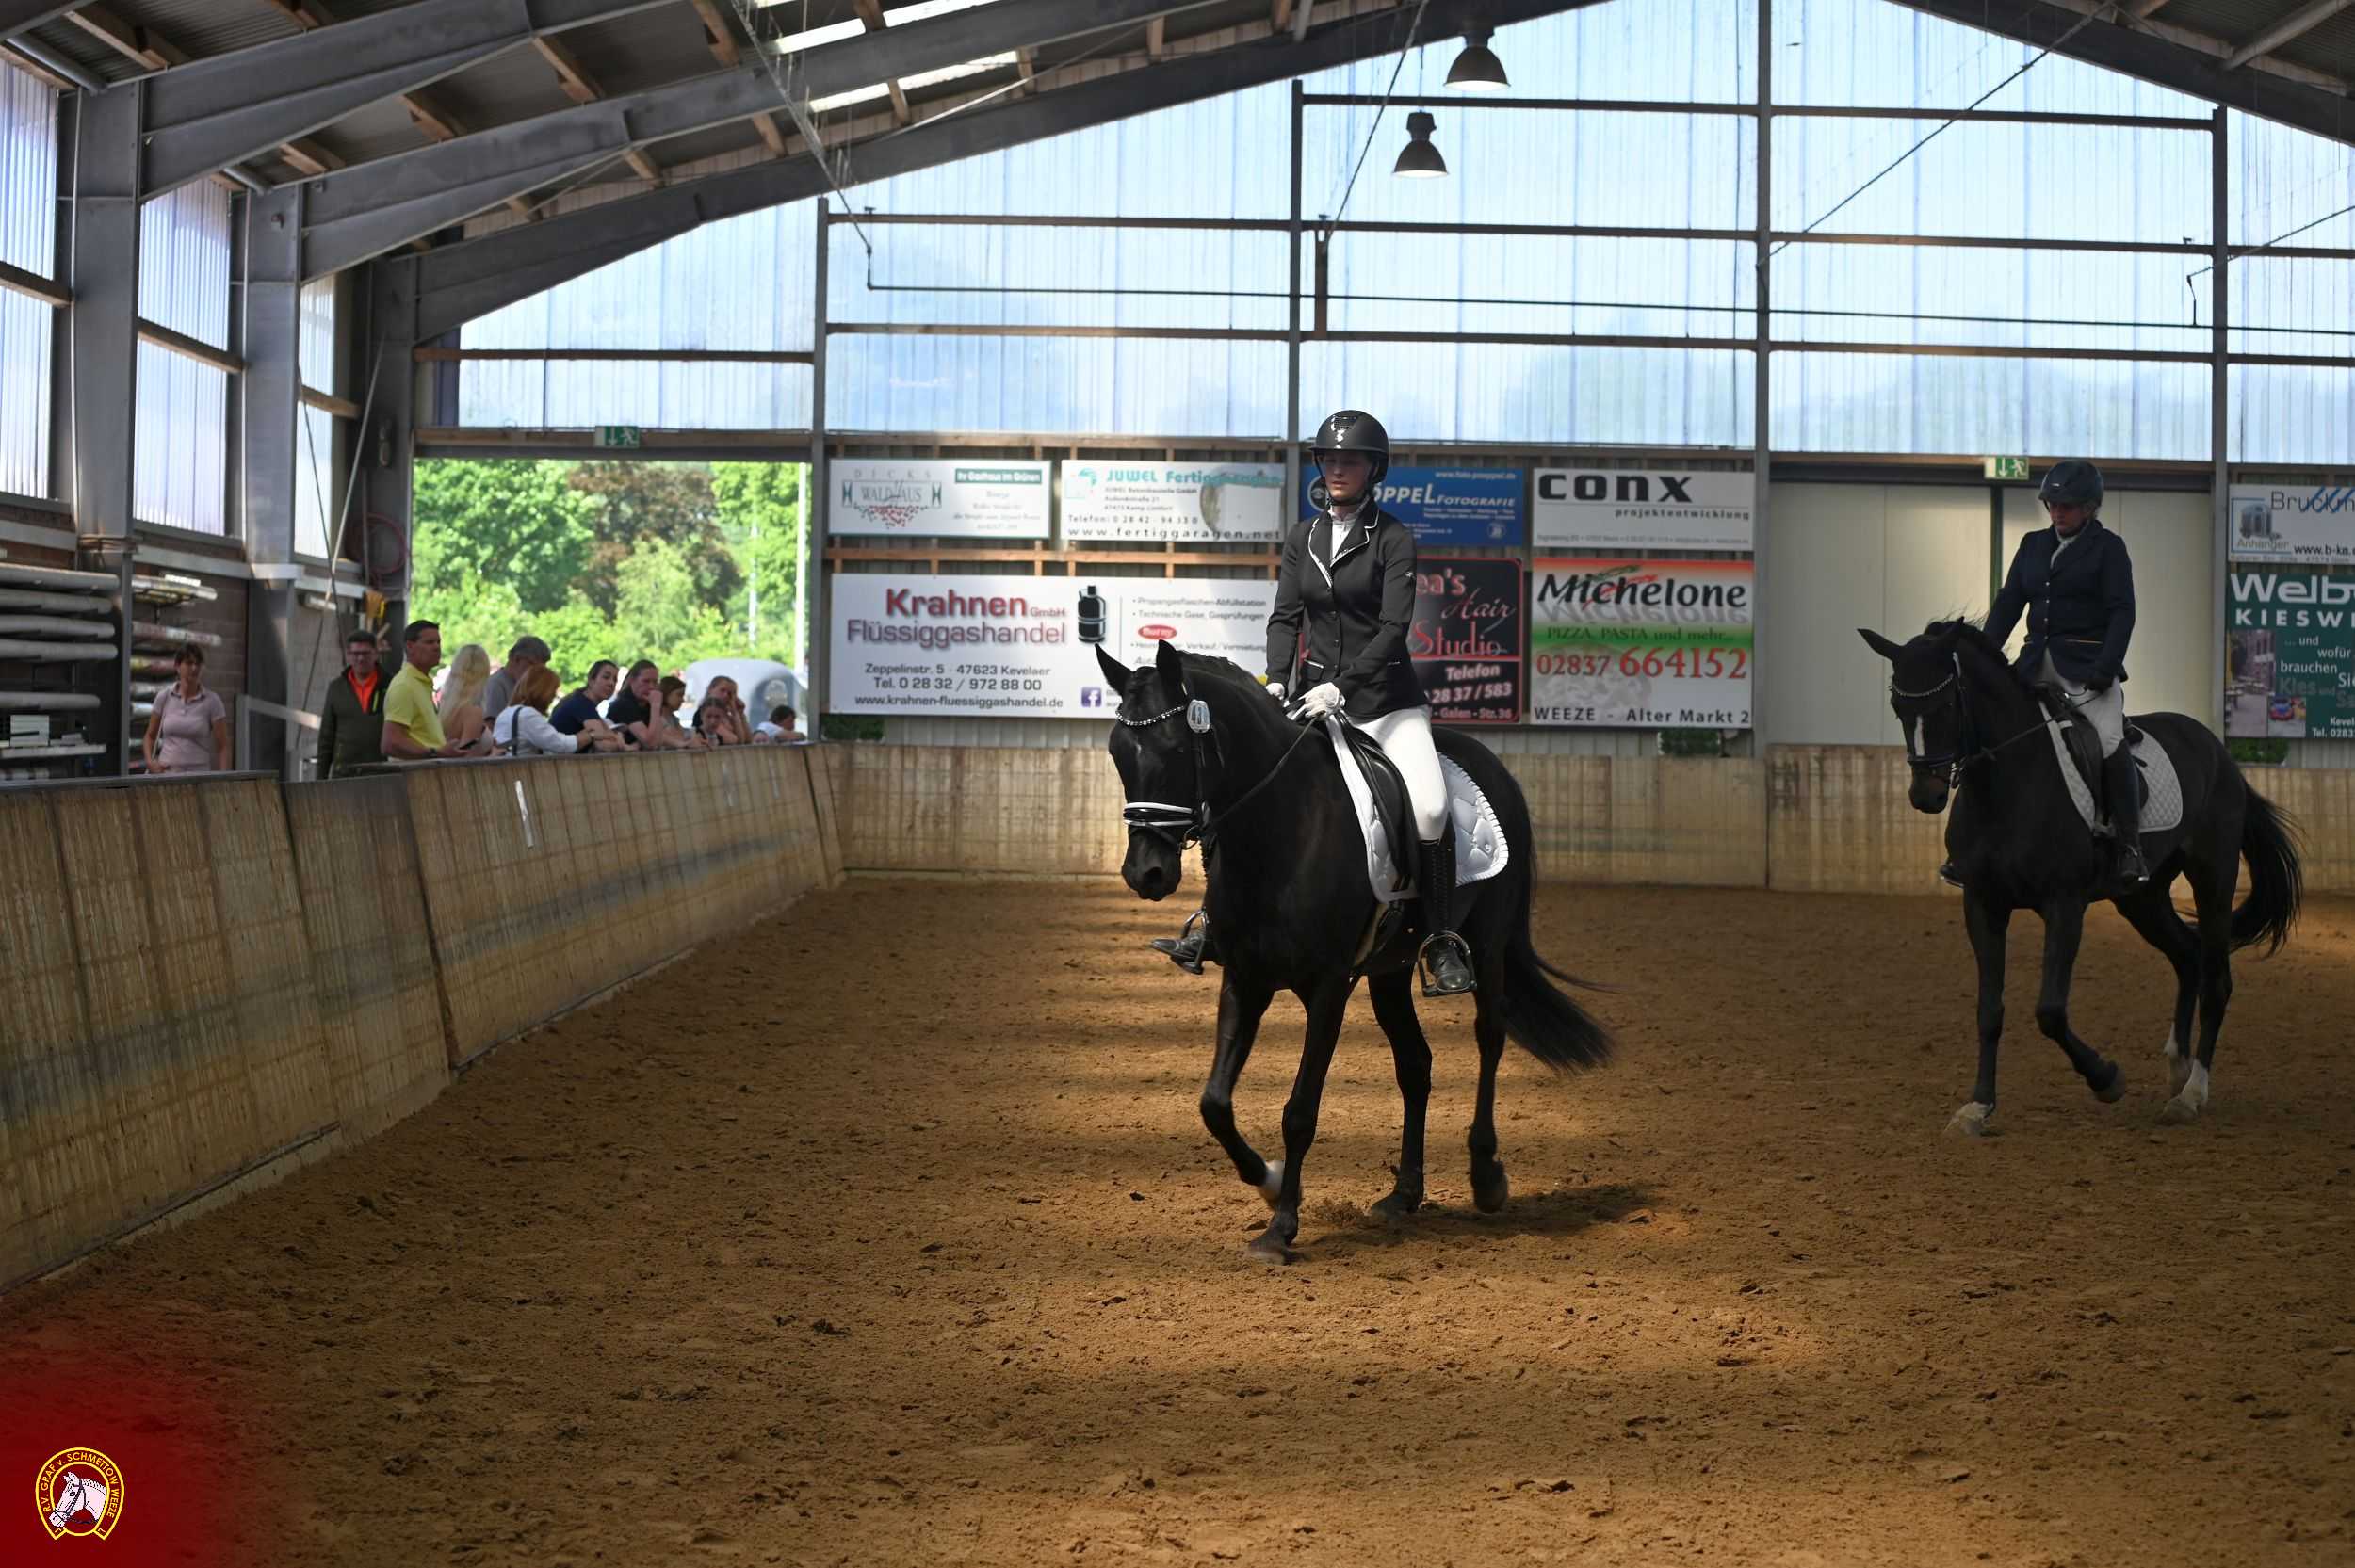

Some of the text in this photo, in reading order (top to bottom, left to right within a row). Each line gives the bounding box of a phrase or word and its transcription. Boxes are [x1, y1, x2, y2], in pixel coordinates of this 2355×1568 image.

[1106, 470, 1158, 483] JUWEL
[1538, 474, 1693, 503] conx
[1068, 515, 1111, 524] Telefon:
[1615, 509, 1750, 521] projektentwicklung
[1415, 567, 1467, 596] ea's
[2231, 574, 2355, 605] Welb
[1537, 574, 1747, 608] Michelone
[886, 588, 1066, 618] Krahnen GmbH
[1441, 587, 1517, 622] Hair
[1138, 610, 1182, 619] Technische
[847, 619, 1066, 650] Flüssiggashandel
[1412, 618, 1507, 656] Studio
[1601, 627, 1648, 640] PASTA
[1654, 630, 1681, 640] und
[2298, 636, 2319, 646] und
[2317, 645, 2351, 660] wofür
[865, 663, 934, 676] Zeppelinstr.
[936, 664, 945, 675] 5
[956, 665, 999, 676] 47623
[1001, 665, 1051, 676] Kevelaer
[1536, 646, 1747, 679] 02837 664152
[2280, 660, 2338, 675] brauchen
[1445, 662, 1501, 682] Telefon
[873, 677, 896, 689] Tel.
[899, 677, 909, 689] 0
[912, 677, 931, 689] 28
[934, 678, 953, 689] 32
[969, 678, 998, 690] 972
[1001, 679, 1020, 690] 88
[1023, 679, 1043, 691] 00
[2280, 676, 2317, 696] Kies
[1431, 688, 1452, 704] 28
[1454, 686, 1472, 703] 37
[1484, 682, 1513, 699] 583
[855, 695, 1064, 709] www.krahnen-fluessiggashandel.de
[1534, 707, 1596, 721] WEEZE
[1626, 708, 1672, 722] Alter
[1679, 709, 1733, 723] Markt
[1741, 711, 1749, 723] 2
[2312, 727, 2355, 738] Tel. 0283
